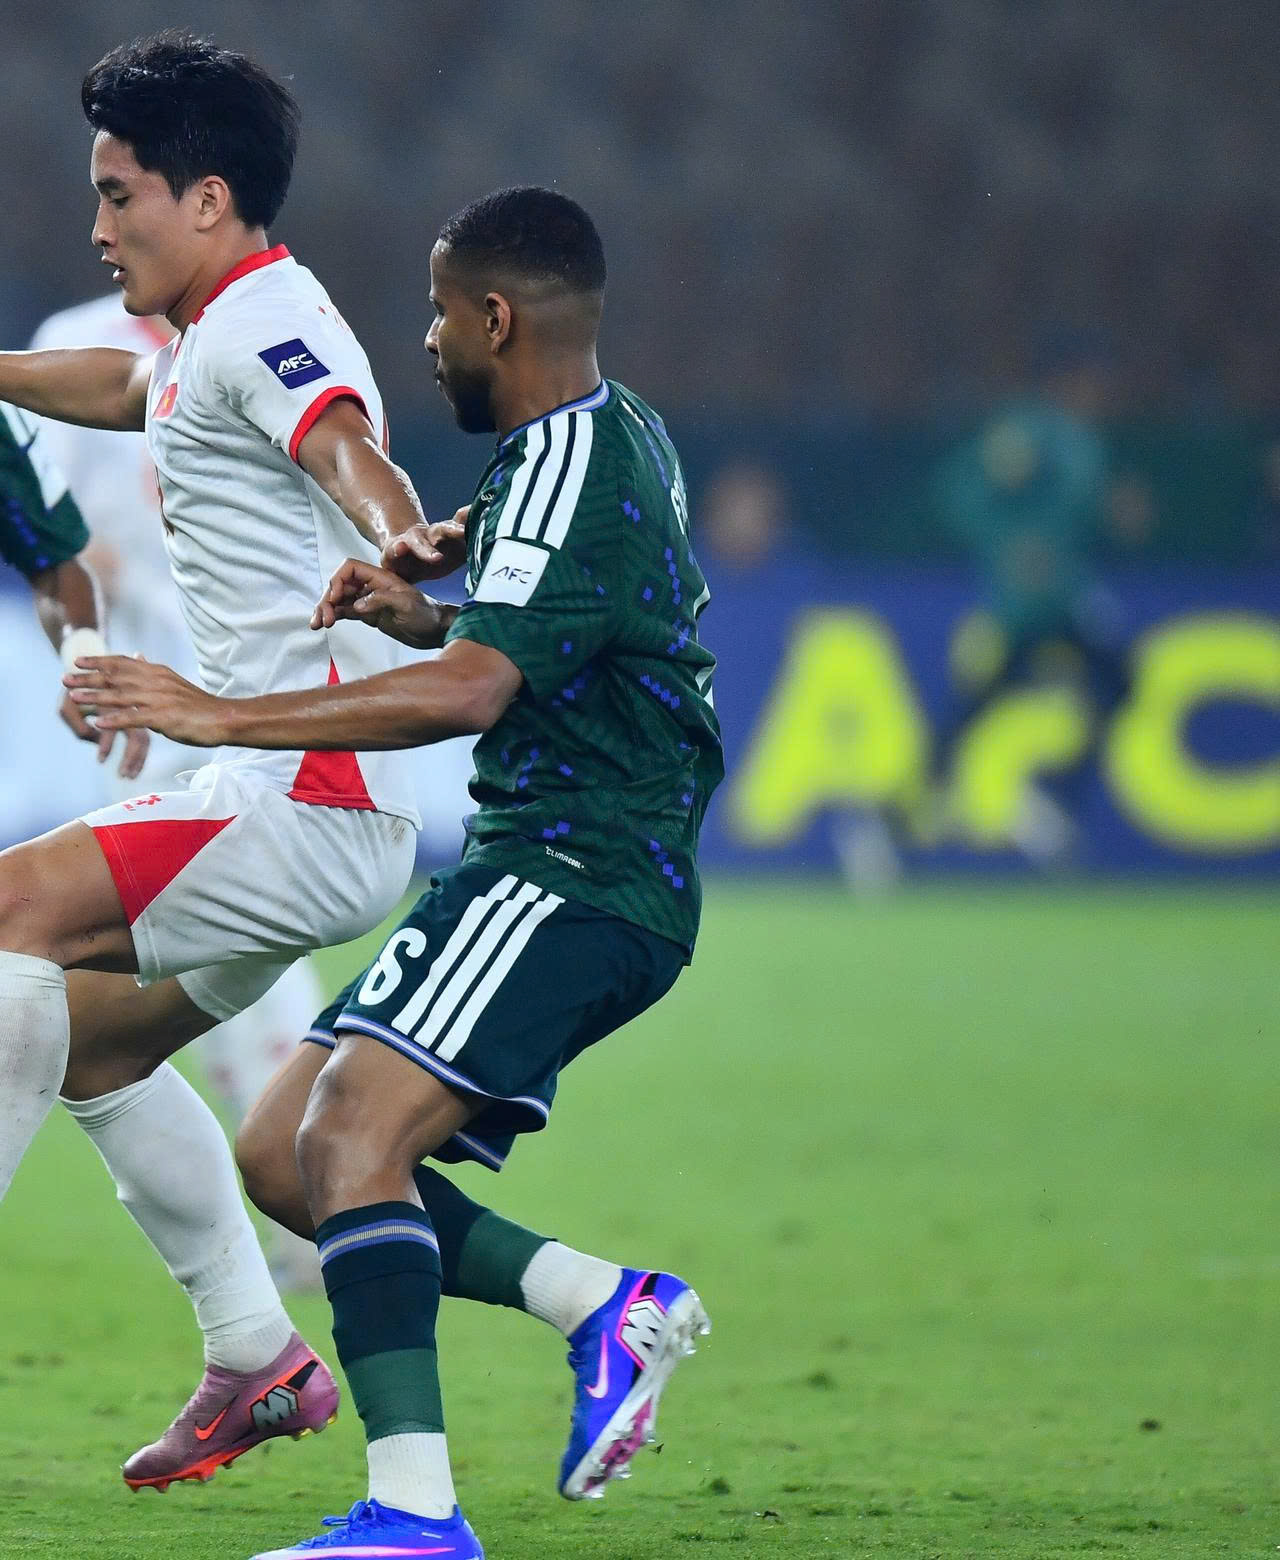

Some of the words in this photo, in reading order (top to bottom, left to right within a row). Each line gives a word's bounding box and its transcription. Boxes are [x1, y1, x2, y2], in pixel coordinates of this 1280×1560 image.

[278, 353, 314, 374] AFC
[491, 566, 533, 584] AFC
[357, 927, 428, 1006] 6
